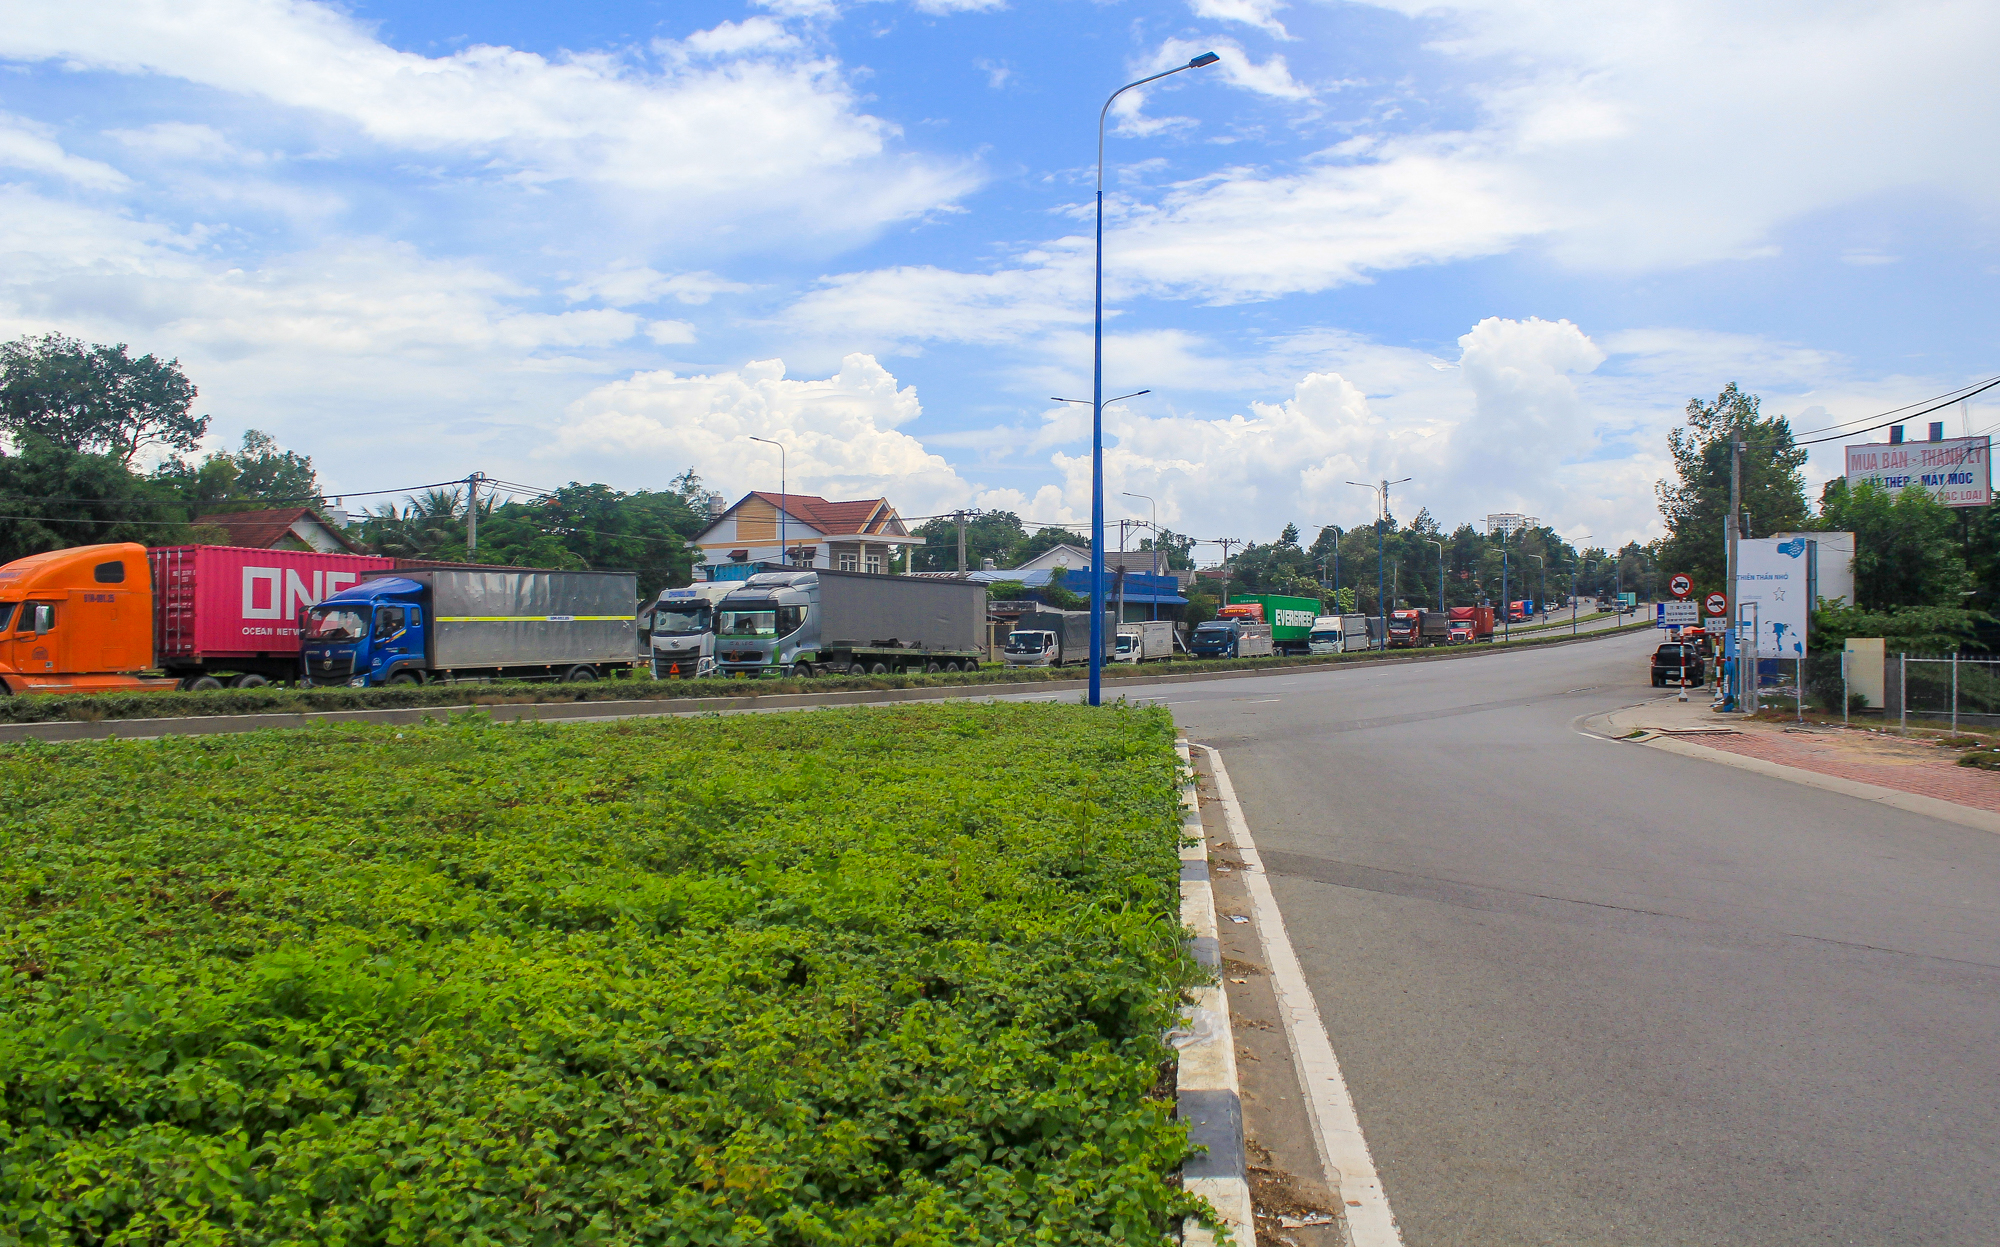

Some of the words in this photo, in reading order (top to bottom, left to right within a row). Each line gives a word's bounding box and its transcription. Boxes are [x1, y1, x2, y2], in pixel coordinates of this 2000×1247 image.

[1851, 453, 1878, 471] MUA
[1882, 448, 1908, 469] BÁN
[1921, 447, 1963, 467] THANH
[1967, 443, 1982, 464] LÝ
[1921, 471, 1945, 487] MÁY
[1948, 470, 1973, 485] MÓC
[242, 627, 273, 636] OCEAN
